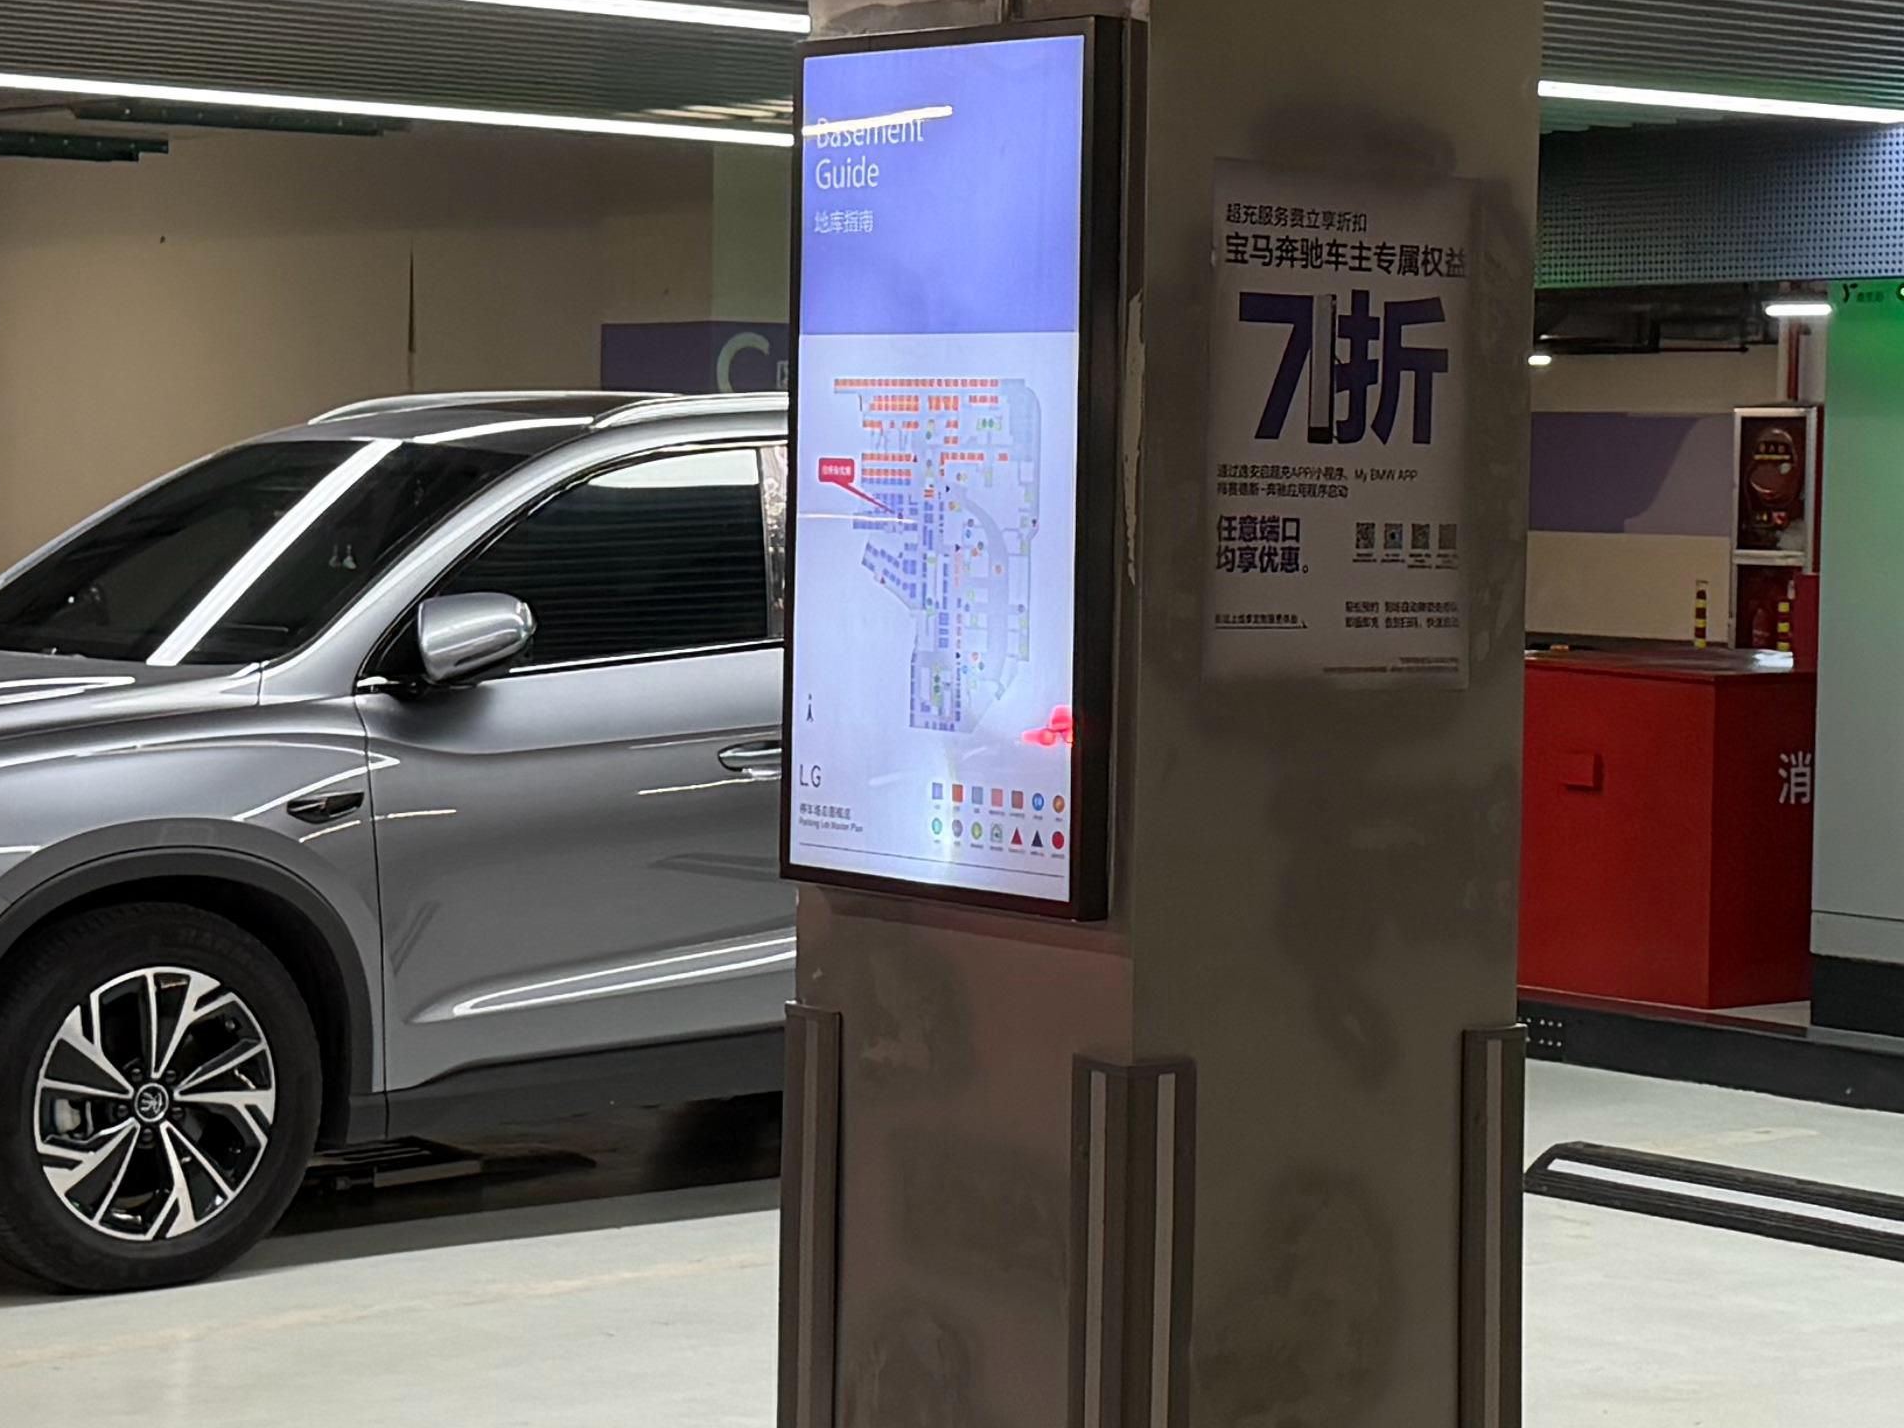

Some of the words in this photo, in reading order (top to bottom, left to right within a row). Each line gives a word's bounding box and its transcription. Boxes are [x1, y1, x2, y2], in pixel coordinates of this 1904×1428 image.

[815, 156, 880, 189] Guide
[814, 210, 874, 234] 地库指南
[1226, 203, 1367, 233] 超充服务费立享折扣
[1225, 232, 1467, 278] 宝马奔驰车主专属权益
[1239, 289, 1448, 445] 7折
[1217, 515, 1300, 543] 任意端口
[800, 764, 822, 789] LG
[1778, 750, 1811, 804] 消
